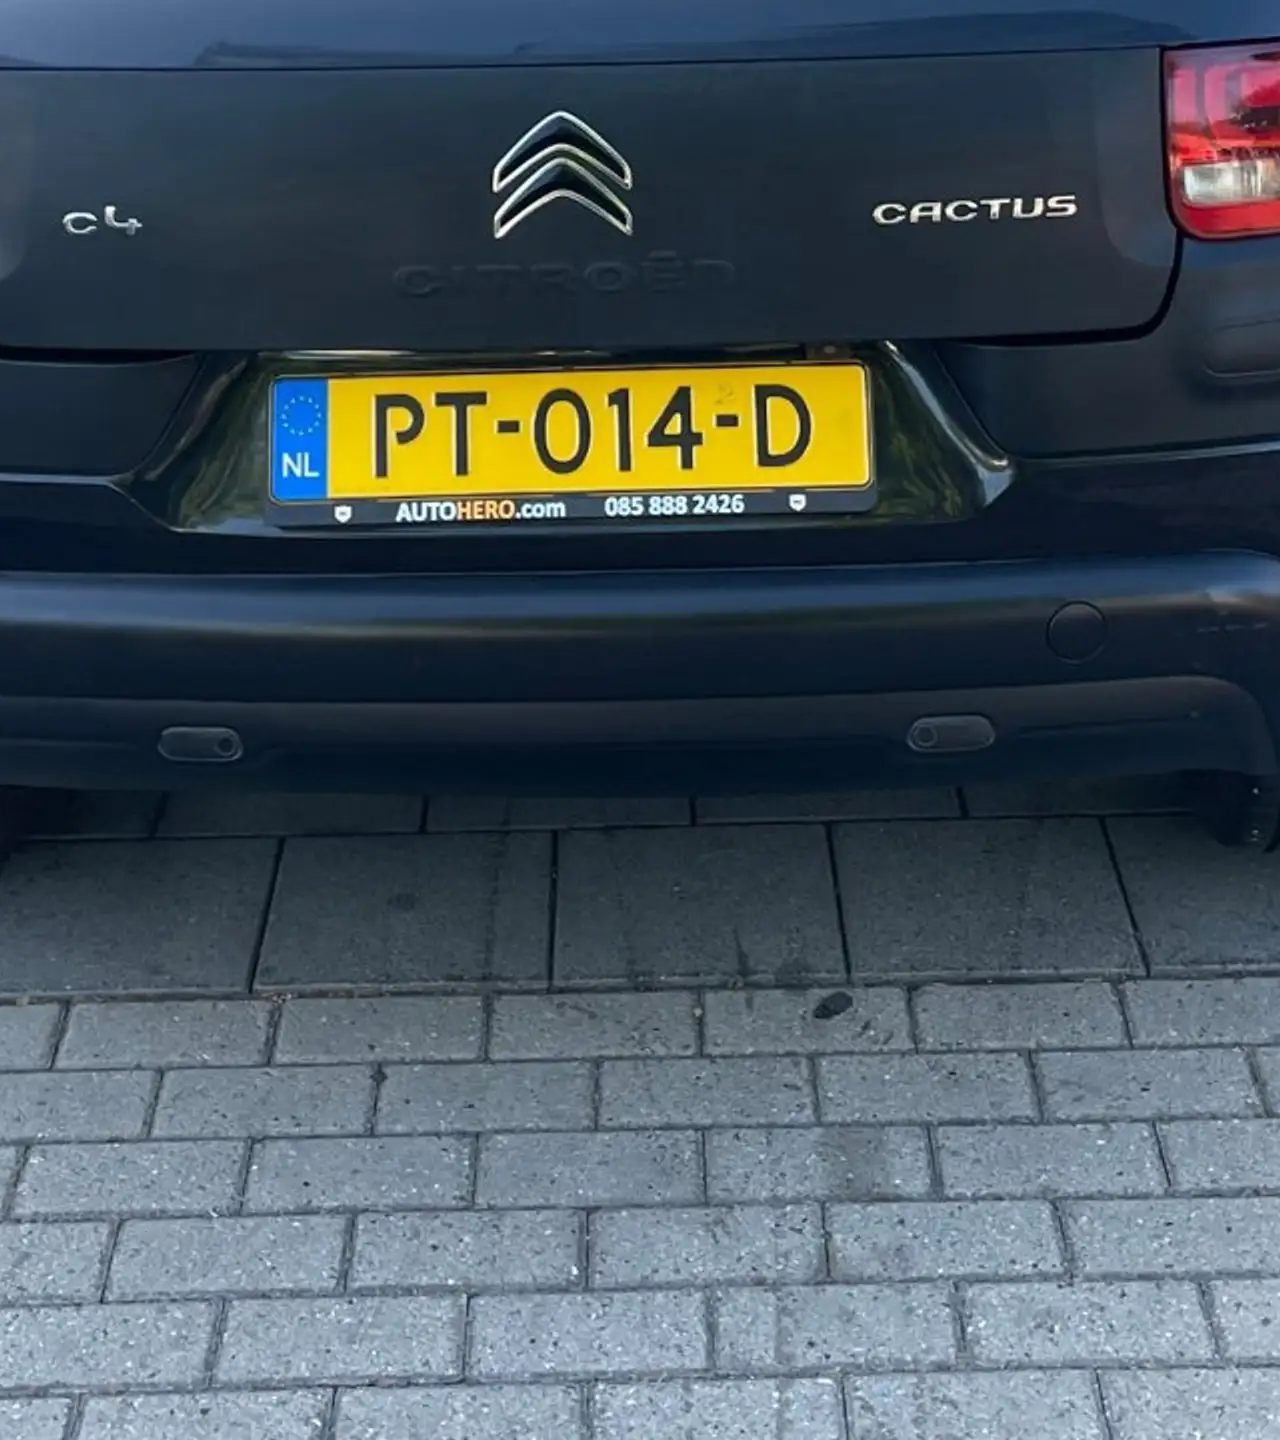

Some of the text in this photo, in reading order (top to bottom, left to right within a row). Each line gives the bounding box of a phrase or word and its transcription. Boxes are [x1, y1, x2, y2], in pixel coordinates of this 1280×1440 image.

[872, 195, 1078, 224] CACTUS
[374, 384, 812, 479] PT-014-D
[282, 453, 320, 479] NL
[395, 498, 566, 523] AUTOHERO.com
[605, 494, 744, 516] 085 888 2426
